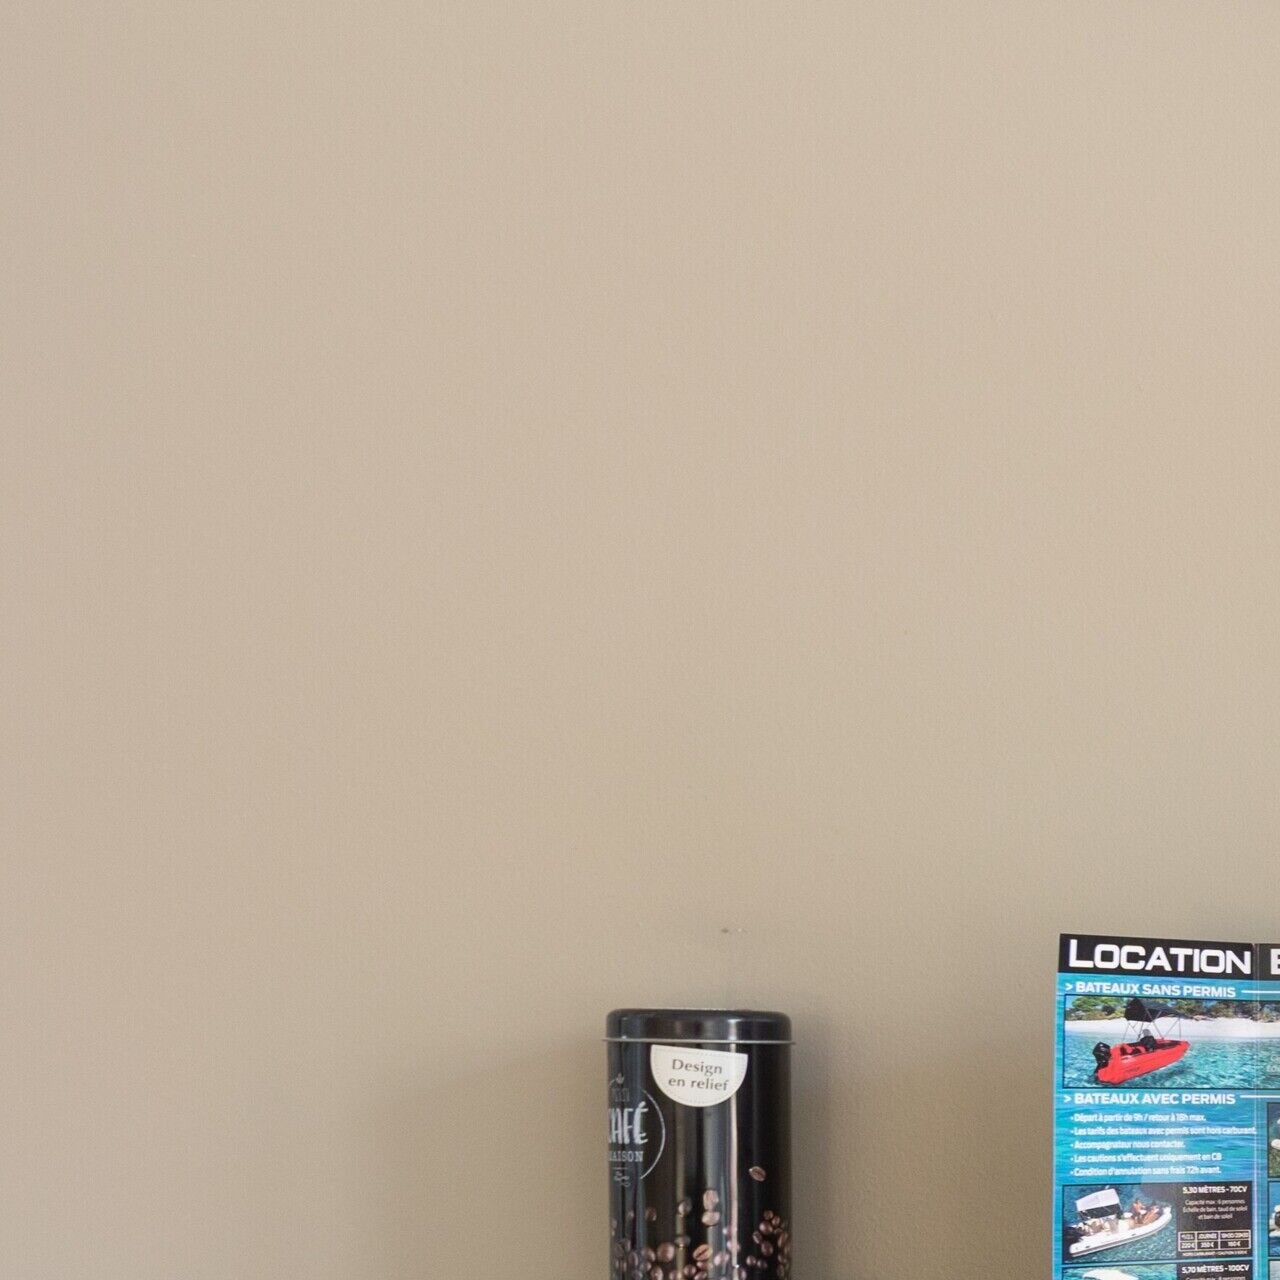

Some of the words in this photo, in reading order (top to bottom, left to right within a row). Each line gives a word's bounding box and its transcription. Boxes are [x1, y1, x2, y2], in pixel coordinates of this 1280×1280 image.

[1069, 939, 1251, 974] LOCATION
[1076, 982, 1140, 994] BATEAUX
[1142, 985, 1181, 996] SANS
[1183, 986, 1236, 998] PERMIS
[672, 1058, 723, 1076] Design
[668, 1078, 686, 1088] en
[690, 1078, 730, 1092] relief
[1074, 1093, 1139, 1104] BATEAUX
[1142, 1093, 1179, 1104] AVEC
[1182, 1093, 1236, 1105] PERMIS
[1198, 1185, 1225, 1193] MÈTRES
[1197, 1265, 1224, 1273] MÈTRES
